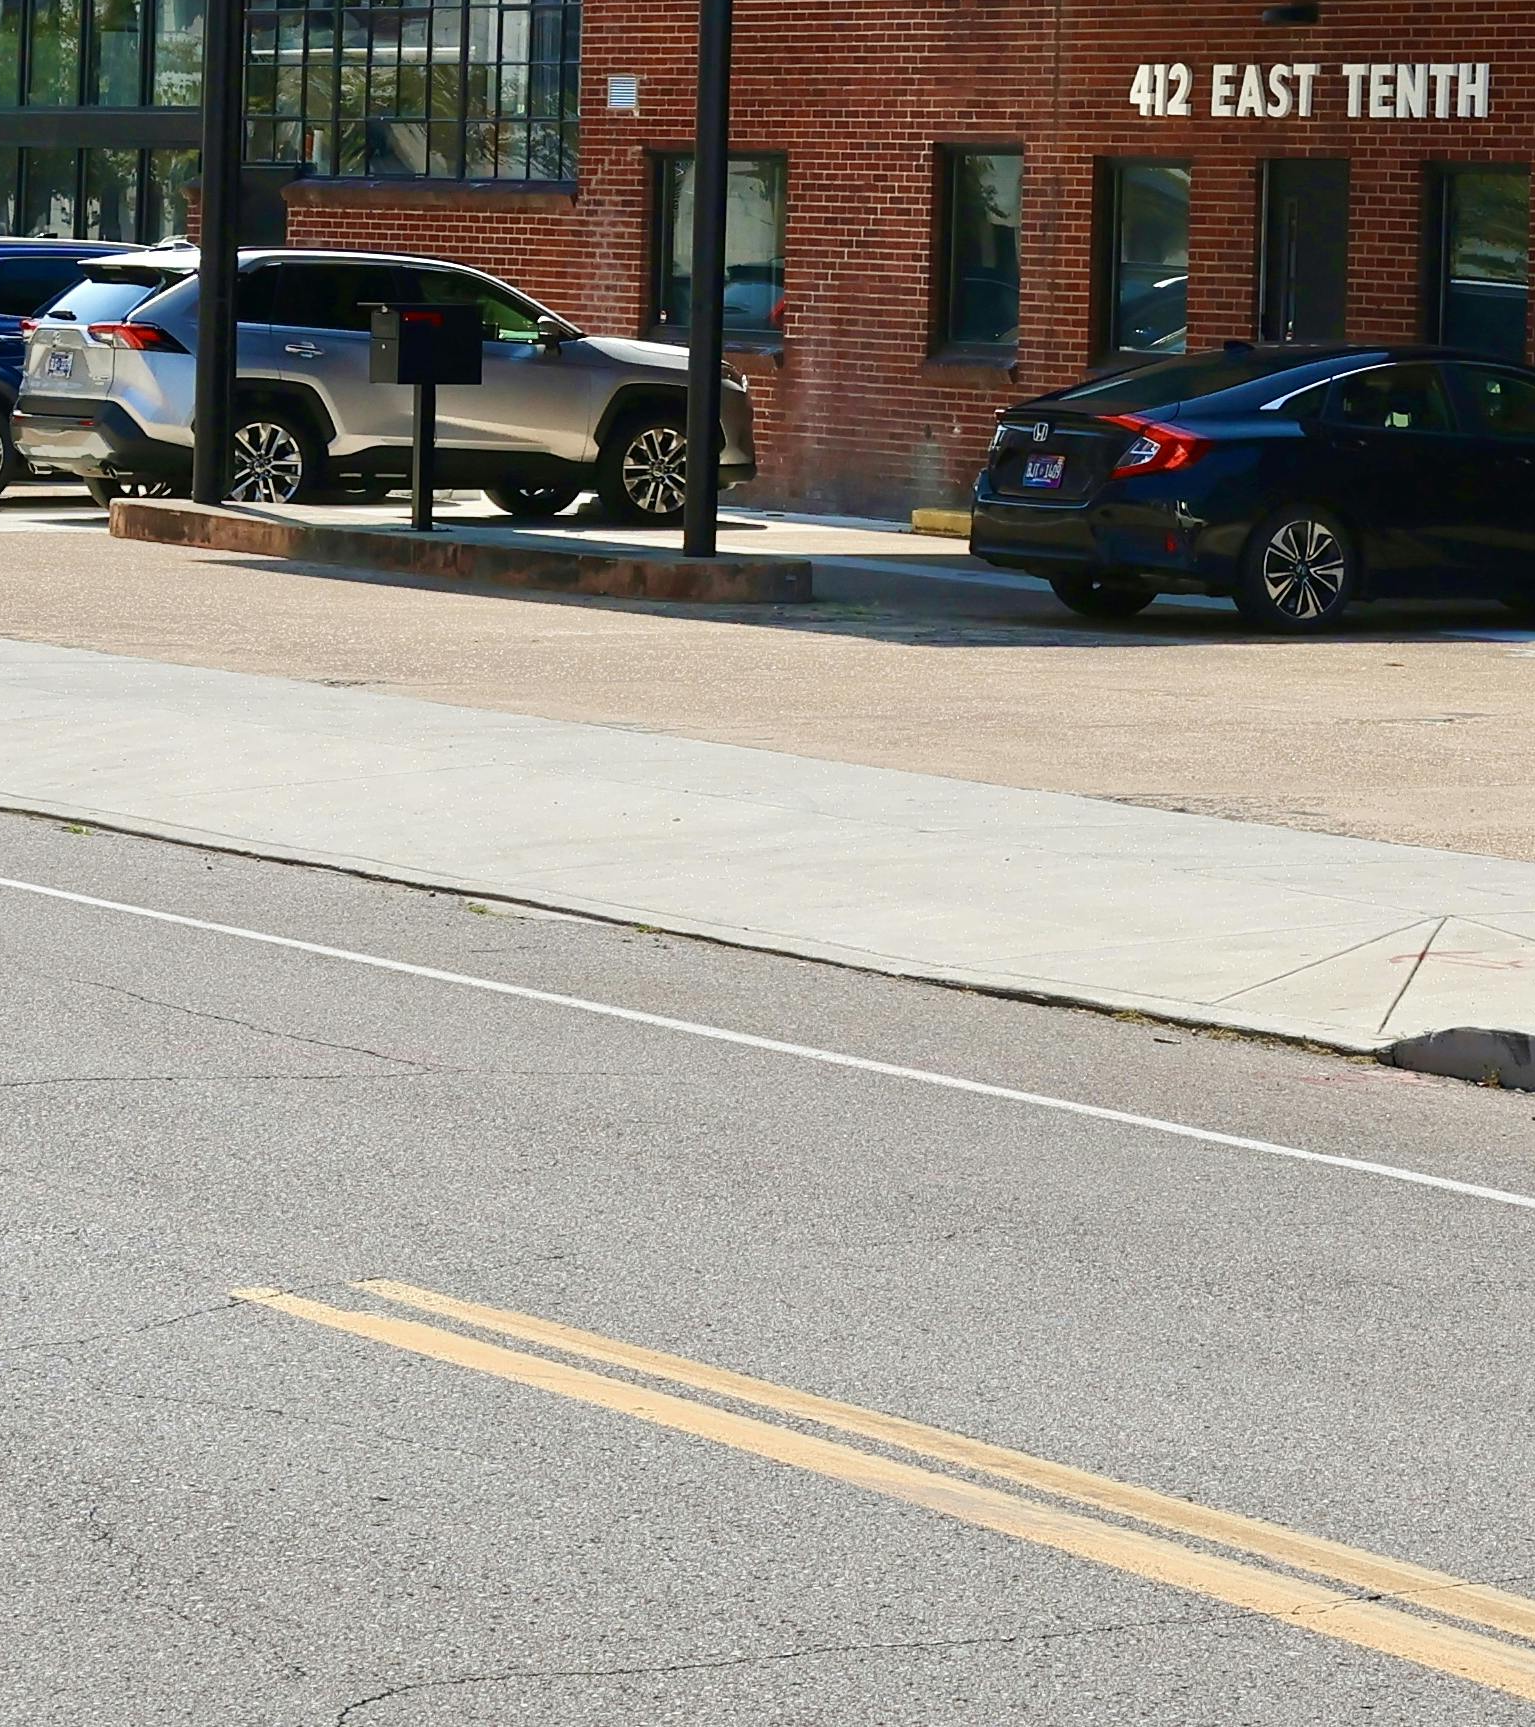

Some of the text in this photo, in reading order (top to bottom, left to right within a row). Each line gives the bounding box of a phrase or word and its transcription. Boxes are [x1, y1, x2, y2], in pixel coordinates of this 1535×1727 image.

[1129, 62, 1490, 119] 412 EAST TENTH
